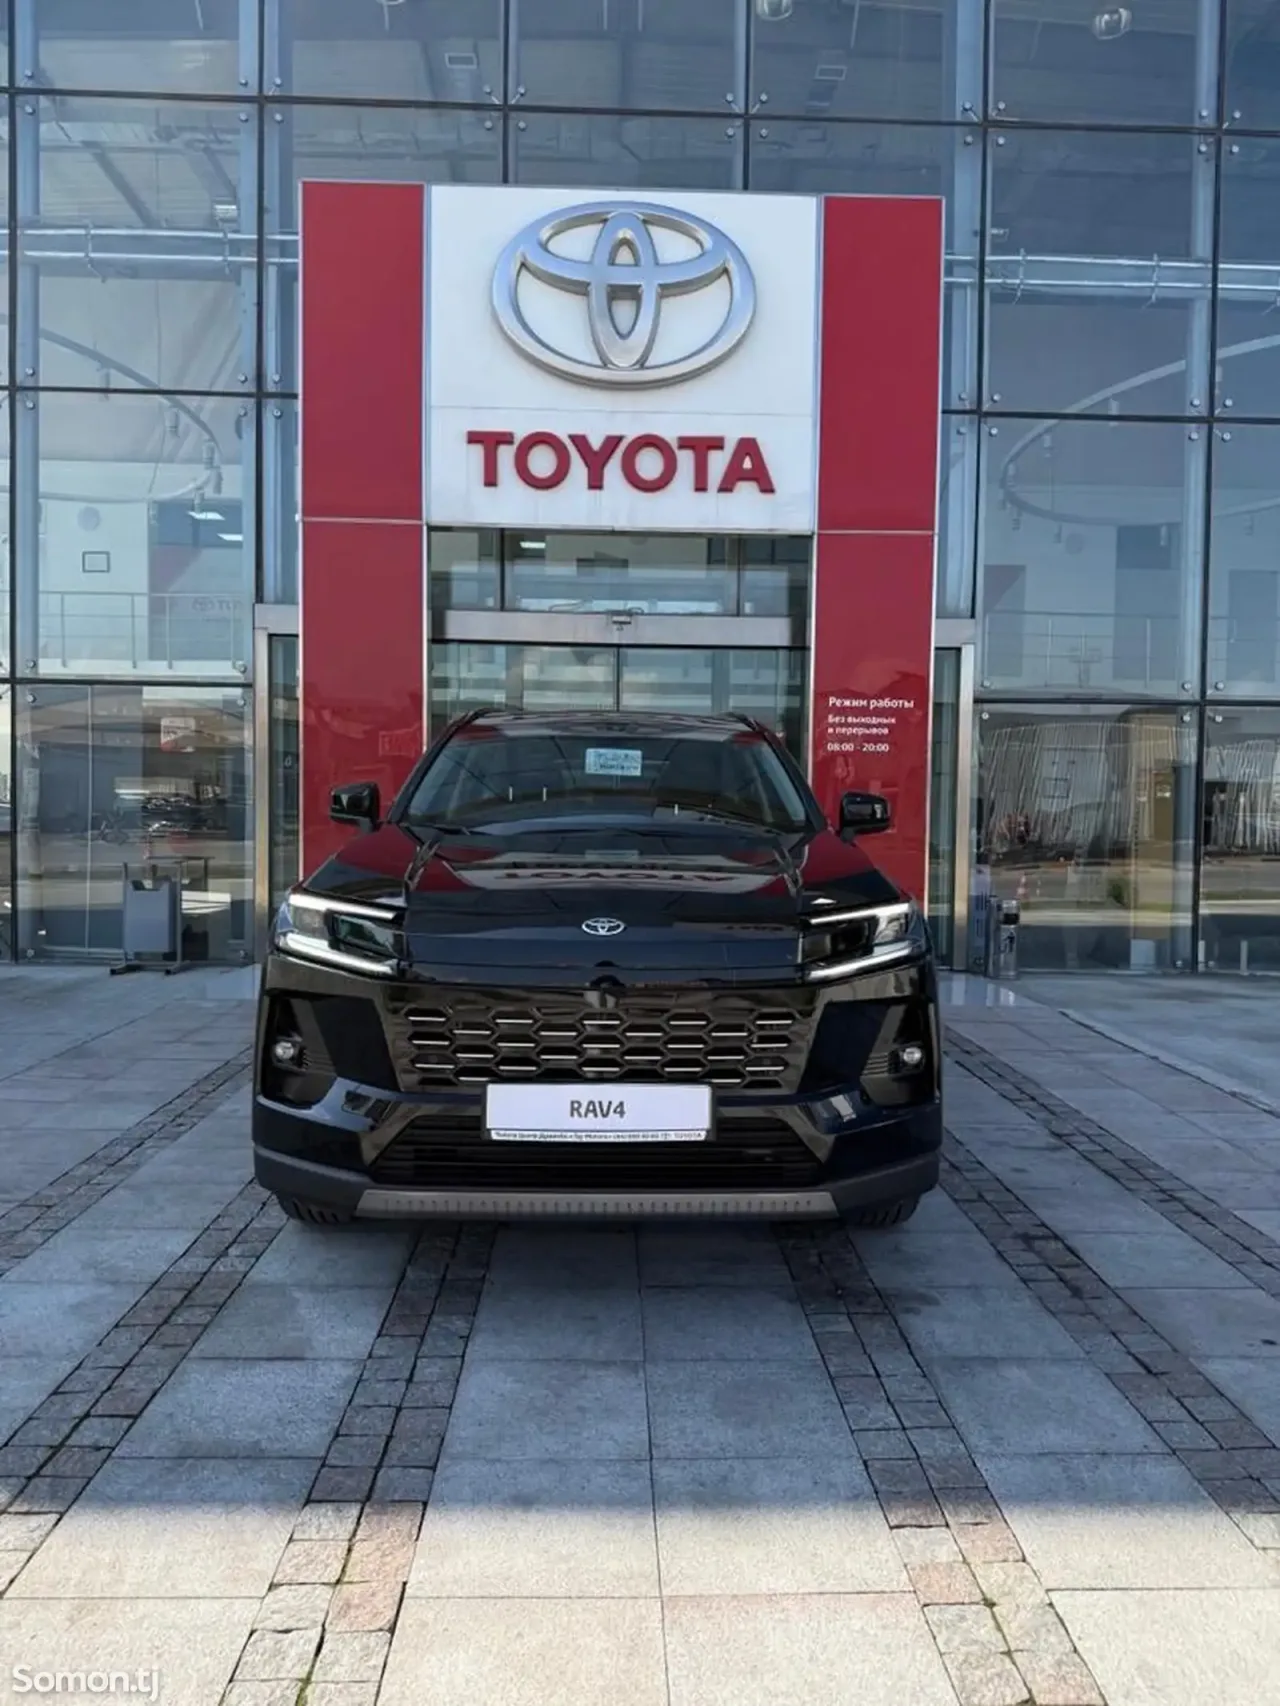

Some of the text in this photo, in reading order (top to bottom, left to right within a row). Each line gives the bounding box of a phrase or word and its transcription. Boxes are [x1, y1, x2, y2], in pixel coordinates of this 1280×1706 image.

[466, 430, 776, 494] TOYOTA
[828, 696, 915, 710] Режим работы
[827, 714, 896, 725] Без выходных
[835, 726, 889, 736] перерывов
[827, 742, 855, 752] 08:00
[861, 742, 889, 752] 20:00
[569, 1099, 626, 1119] RAV4
